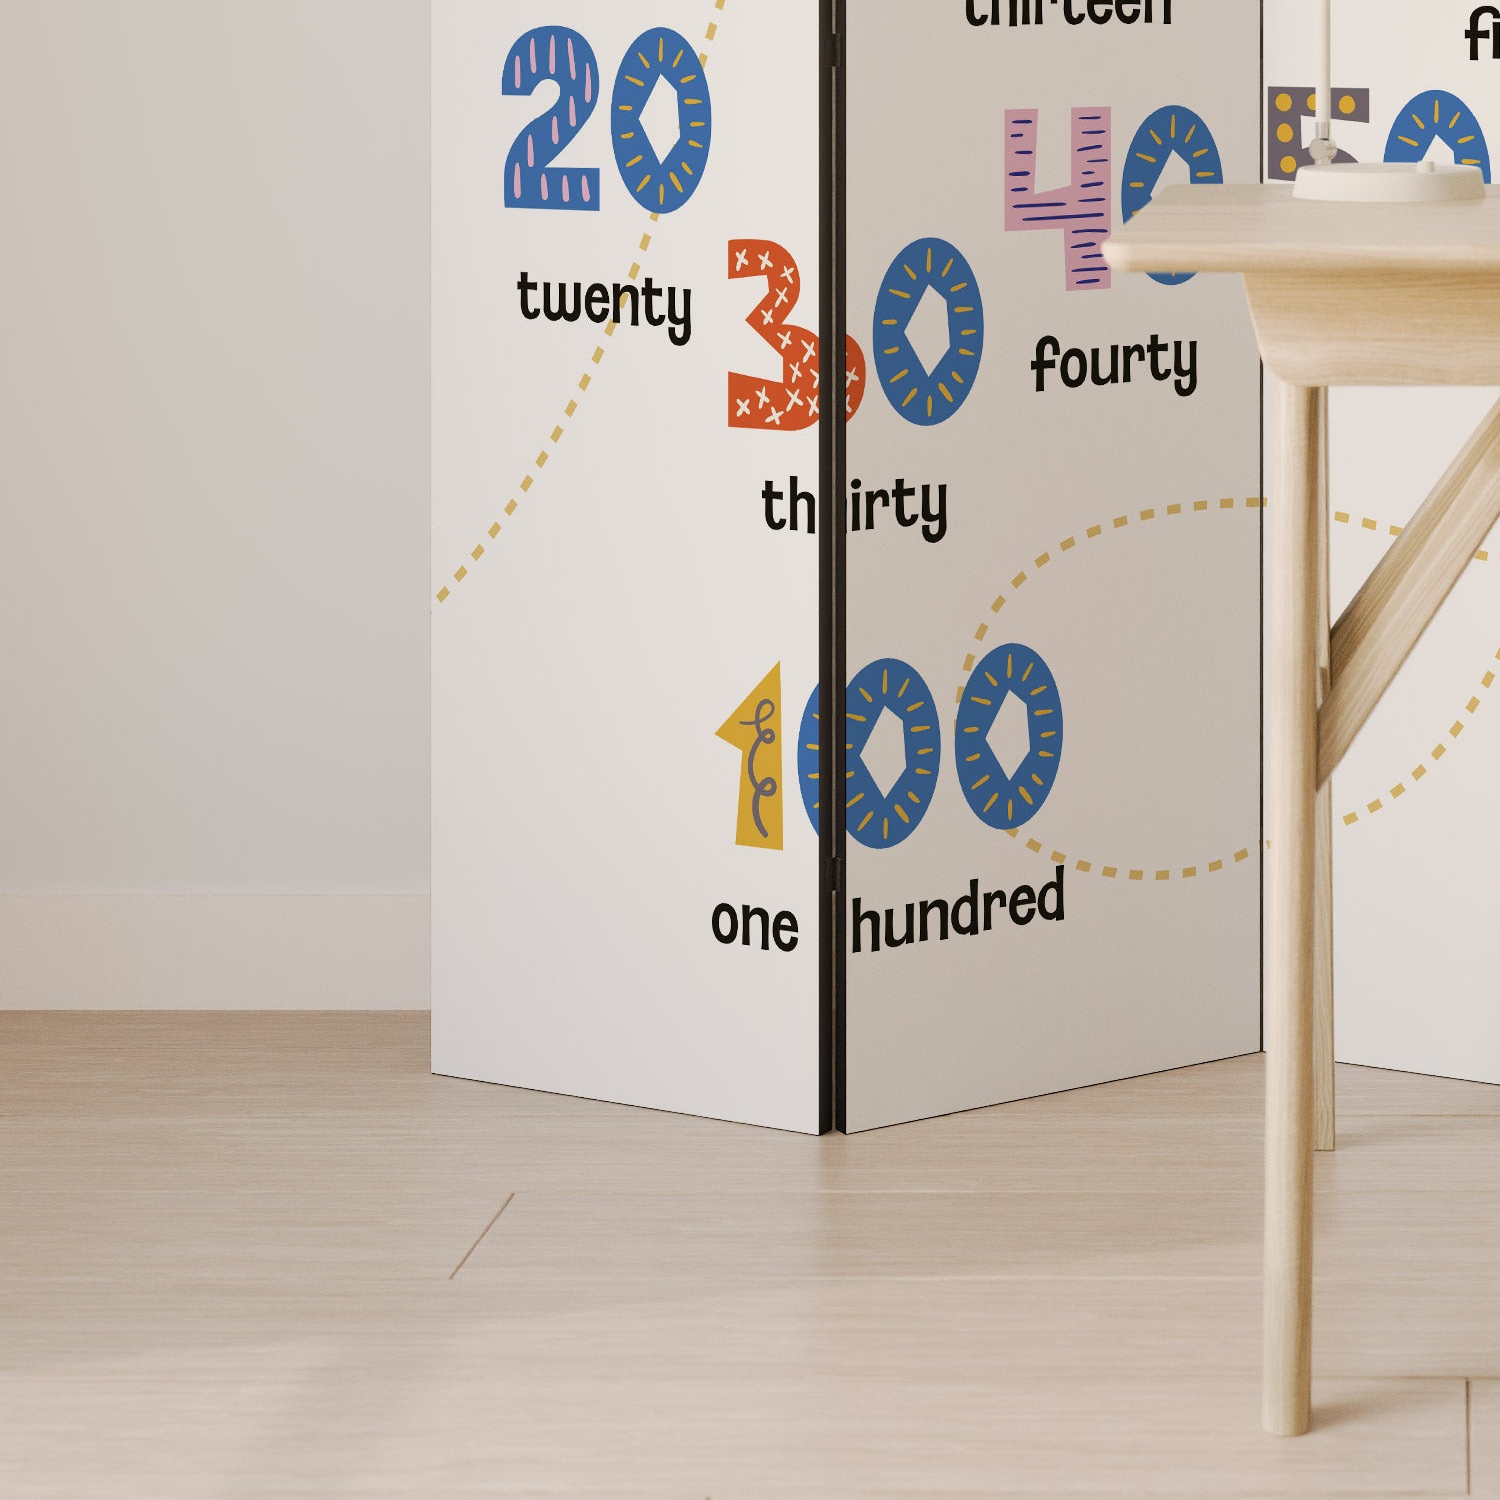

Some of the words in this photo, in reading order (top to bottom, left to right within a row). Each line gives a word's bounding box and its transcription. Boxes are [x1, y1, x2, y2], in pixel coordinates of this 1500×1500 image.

[502, 26, 712, 214] 20
[518, 272, 692, 346] twenty
[729, 237, 984, 430] 30
[1031, 334, 1198, 397] fourty
[762, 476, 947, 543] thirty
[716, 643, 1063, 850] 100
[712, 903, 799, 952] one
[852, 865, 1065, 953] hundred
